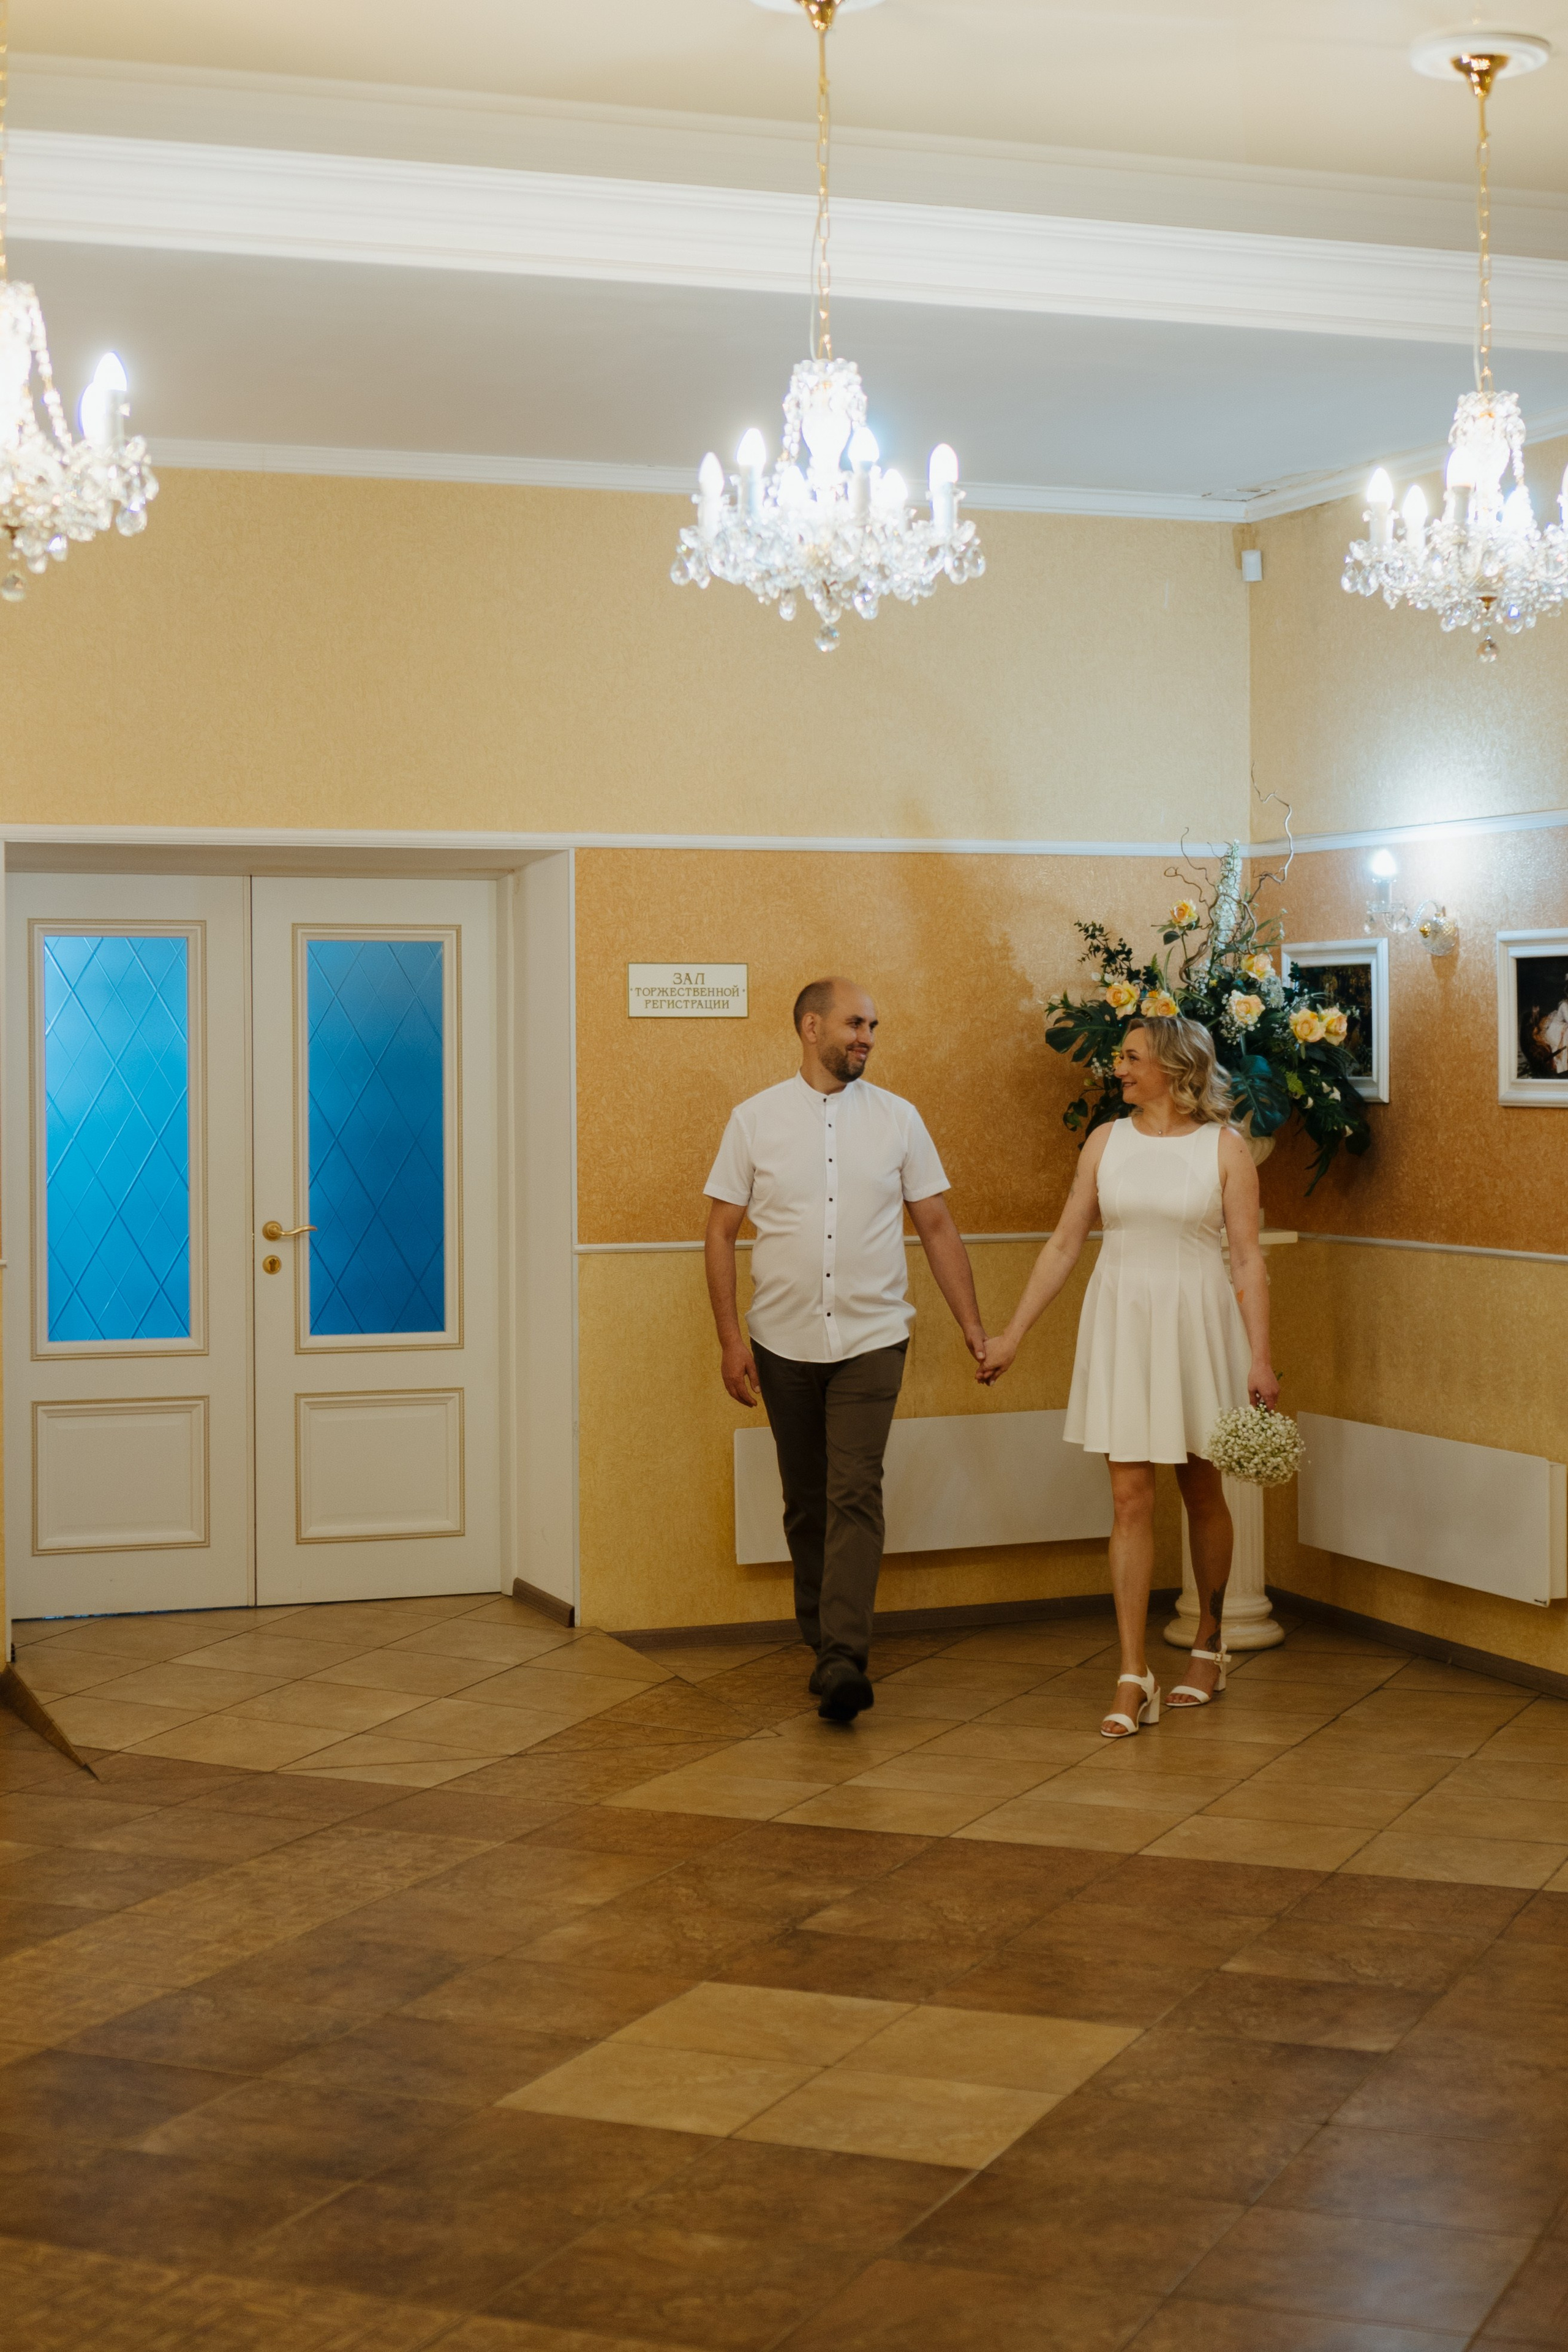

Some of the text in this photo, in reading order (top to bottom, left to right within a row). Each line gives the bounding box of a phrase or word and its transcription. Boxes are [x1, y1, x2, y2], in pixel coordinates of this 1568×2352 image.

[673, 972, 705, 985] ЗАЛ
[635, 985, 739, 997] ТОРЖЕСТВЕННОЙ
[644, 1000, 729, 1010] РЕГИСТРАЦИИ
